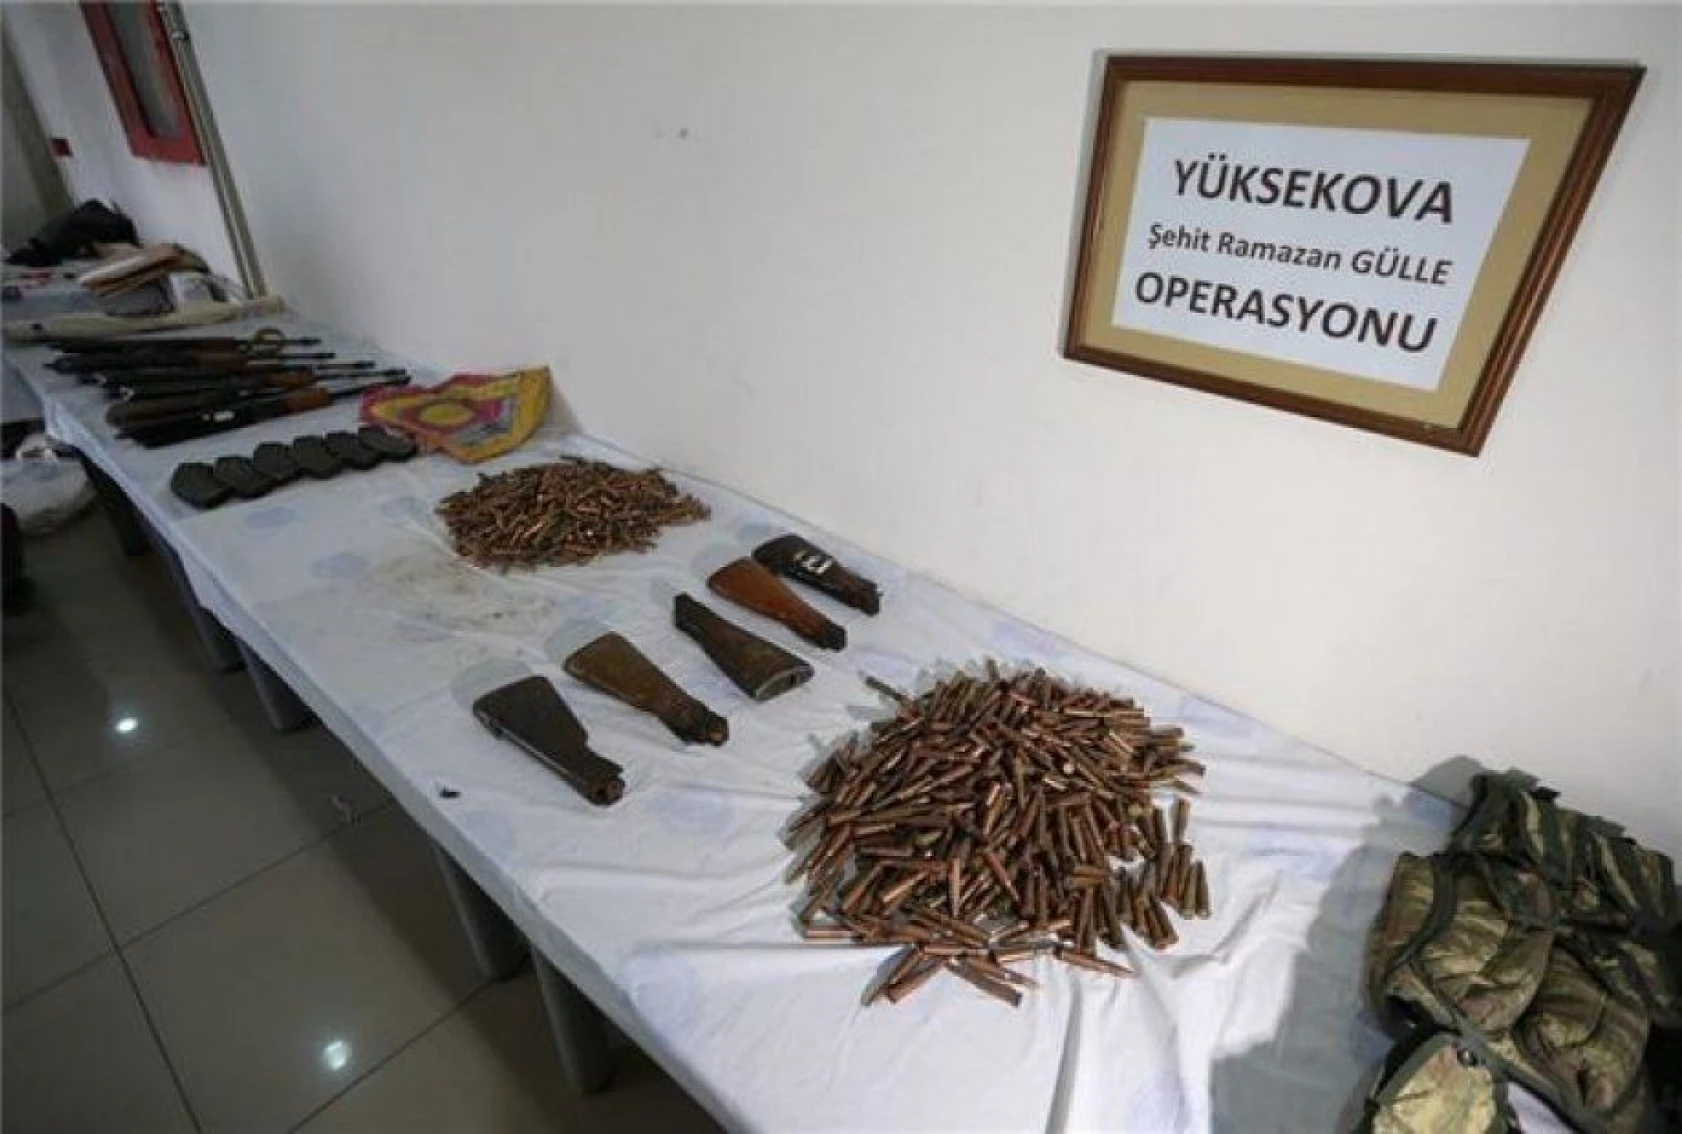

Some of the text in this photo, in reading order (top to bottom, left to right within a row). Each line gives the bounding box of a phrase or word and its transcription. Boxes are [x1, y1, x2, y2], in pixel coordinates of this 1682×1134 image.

[1174, 151, 1453, 226] YÜKSEKOVA
[1148, 222, 1453, 286] Şehit Ramazan GÜLLE
[1134, 271, 1438, 354] OPERASYONU
